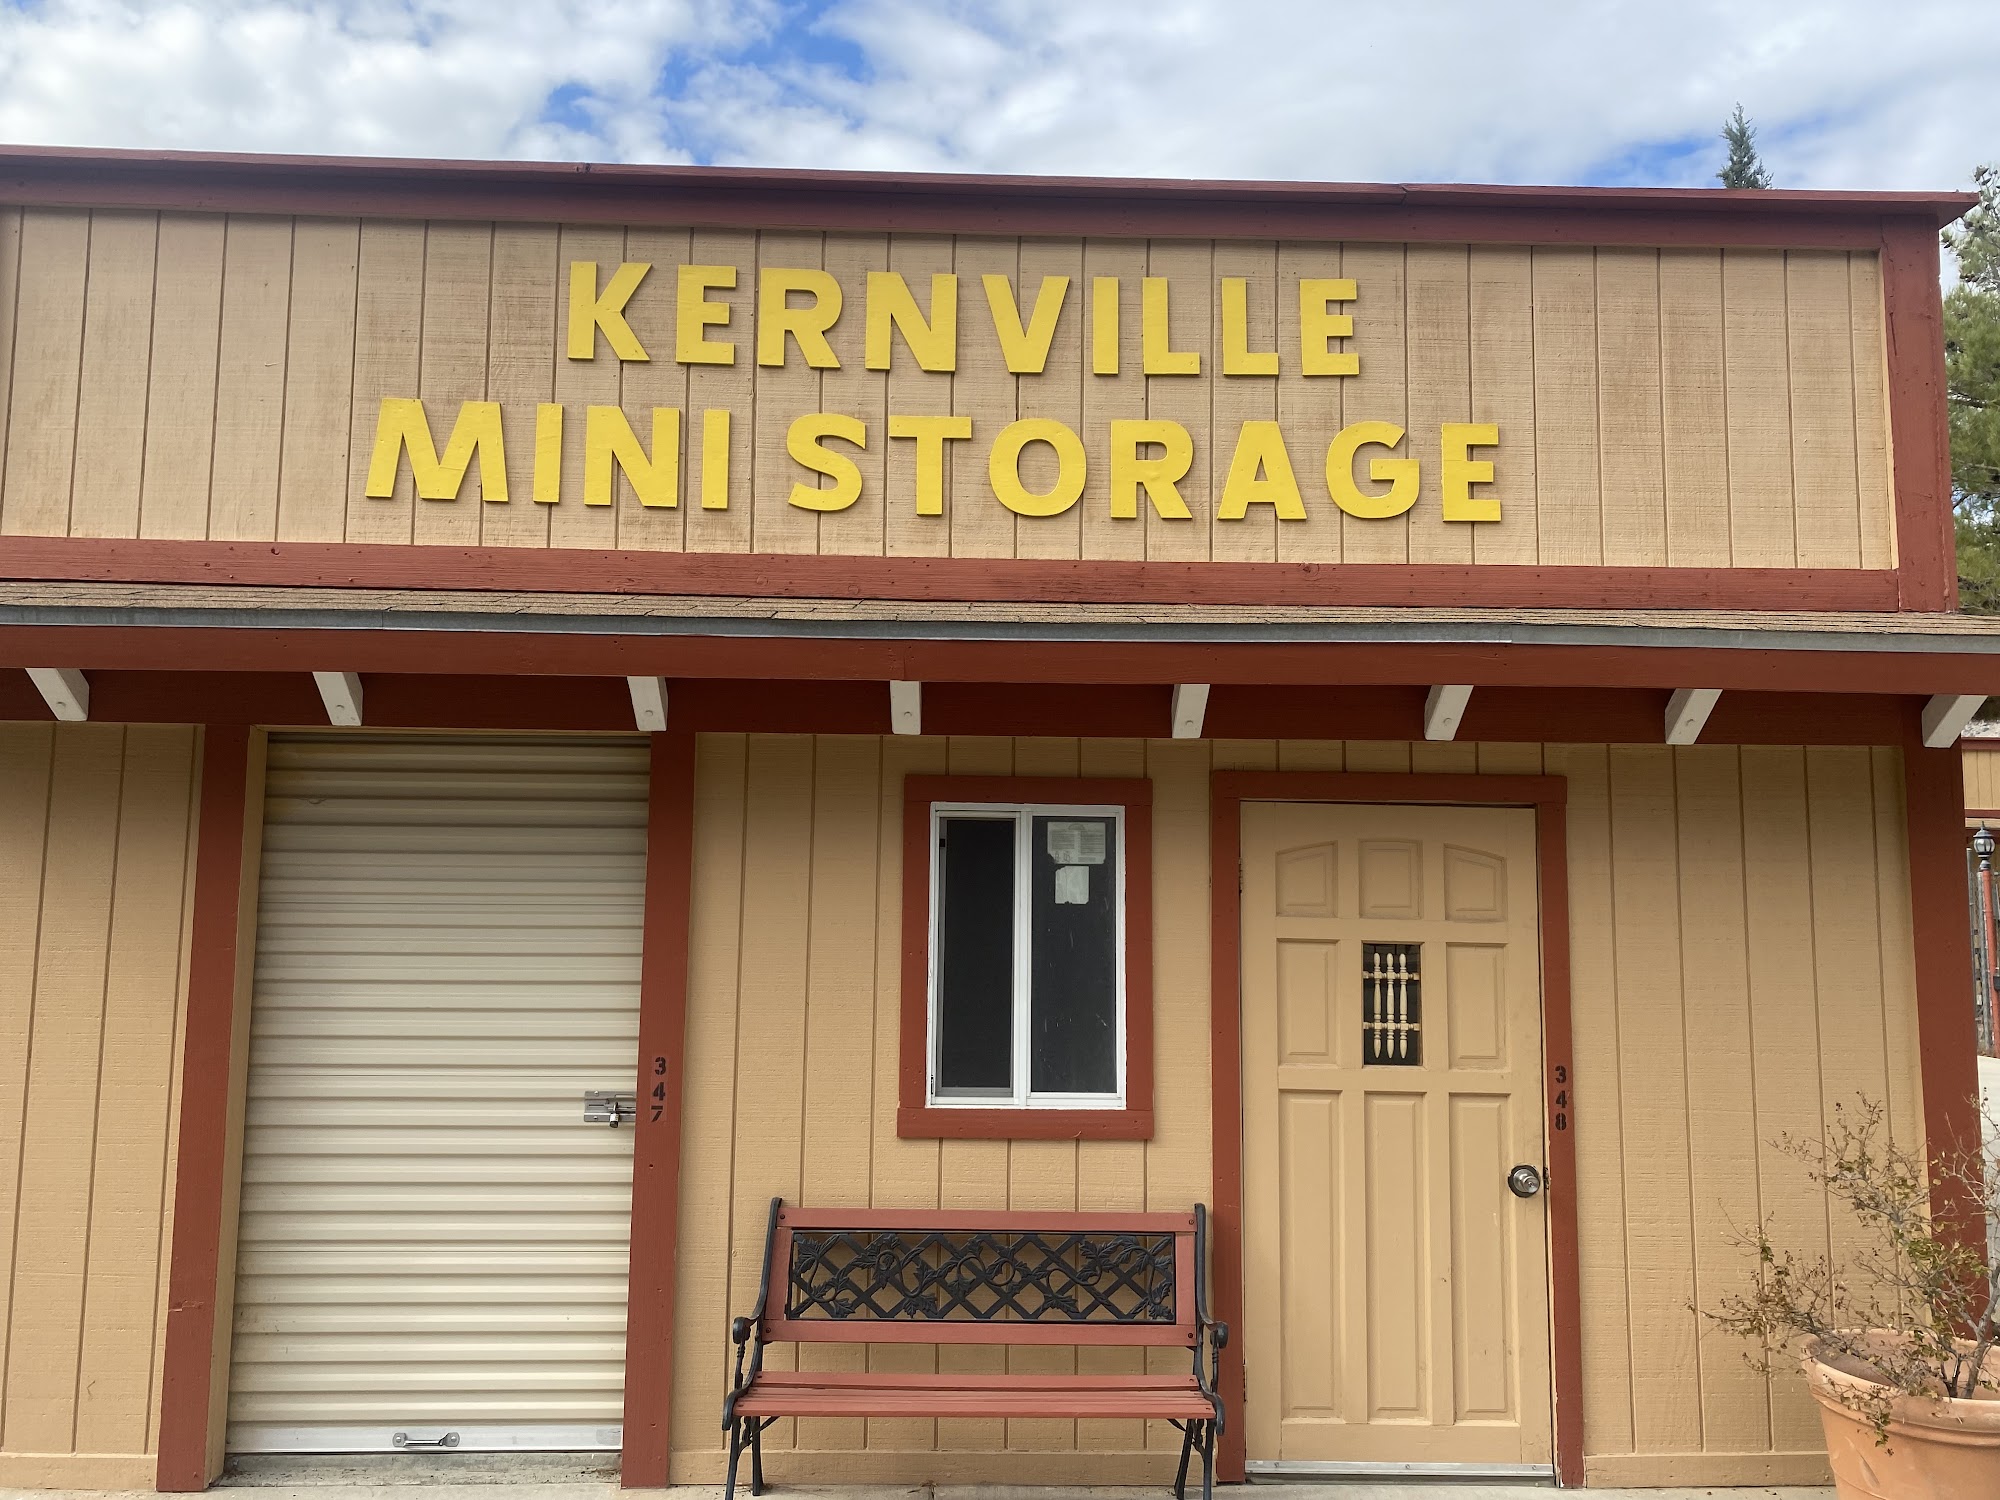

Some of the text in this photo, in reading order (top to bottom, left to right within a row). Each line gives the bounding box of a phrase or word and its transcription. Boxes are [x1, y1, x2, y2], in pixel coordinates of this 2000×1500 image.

[568, 260, 1360, 376] KERNVILLE
[366, 397, 1502, 523] MINI STORAGE
[650, 1057, 667, 1122] 347
[1554, 1065, 1568, 1131] 348
